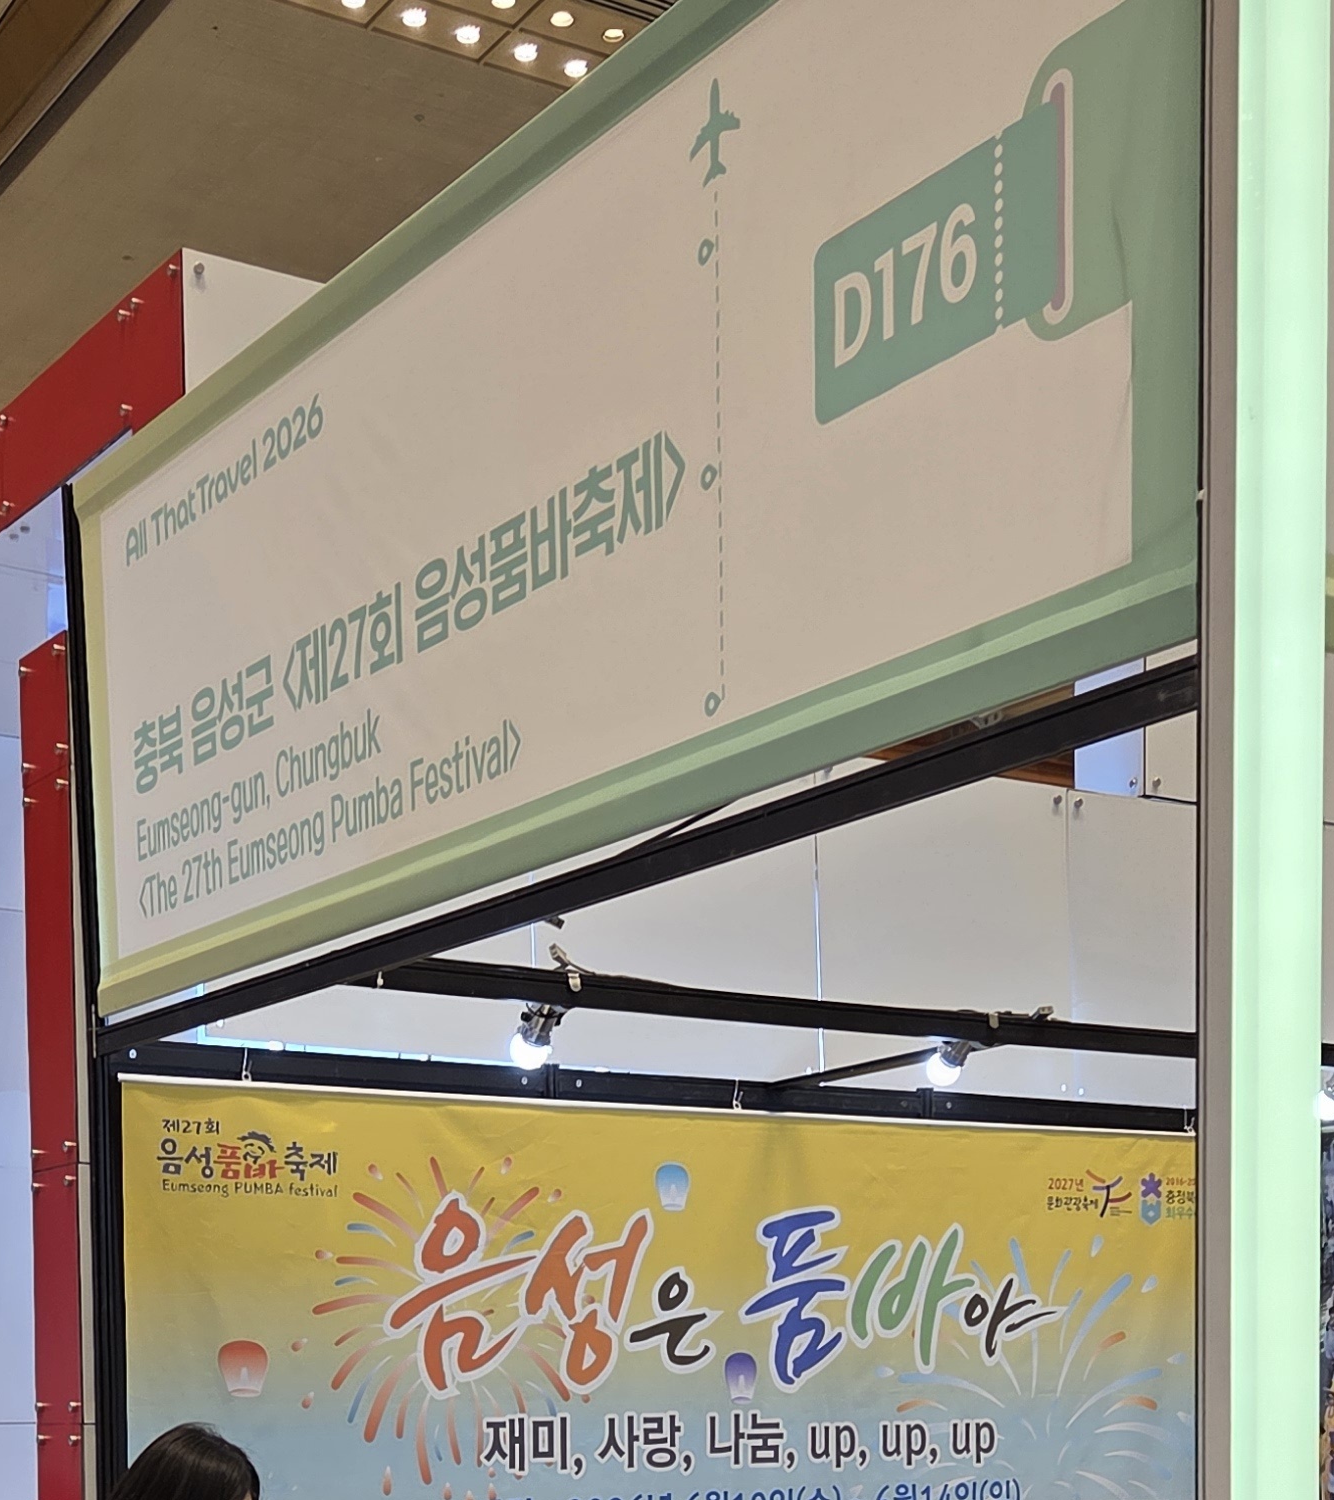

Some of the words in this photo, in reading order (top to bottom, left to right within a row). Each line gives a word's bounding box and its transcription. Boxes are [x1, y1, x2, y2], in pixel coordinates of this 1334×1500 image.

[833, 202, 977, 368] D176
[125, 517, 148, 567] All
[151, 488, 197, 546] That
[197, 438, 257, 515] Travel
[263, 397, 324, 472] 2026
[133, 704, 184, 794] 충북
[191, 654, 275, 766] 음성군
[137, 770, 271, 862] Eumseong-gun,
[276, 708, 382, 798] Chungbuk
[182, 847, 223, 904] 27th
[228, 808, 325, 885] Eumseong
[331, 775, 403, 843] Pumba
[156, 1137, 338, 1182] 음성품바축제
[162, 1117, 220, 1135] 제27회
[162, 1179, 230, 1198] Eumseong
[234, 1182, 284, 1195] PUMBA
[289, 1182, 338, 1198] festival
[1047, 1177, 1085, 1192] 2027년
[1165, 1189, 1196, 1205] 충청북
[389, 1199, 712, 1391] 음성은
[747, 1209, 1057, 1386] 품바야
[483, 1414, 585, 1478] 재미,
[597, 1412, 693, 1475] 사랑,
[707, 1411, 796, 1470] 나눔,
[810, 1419, 867, 1470] up,
[882, 1418, 937, 1467] up,
[951, 1417, 996, 1465] up
